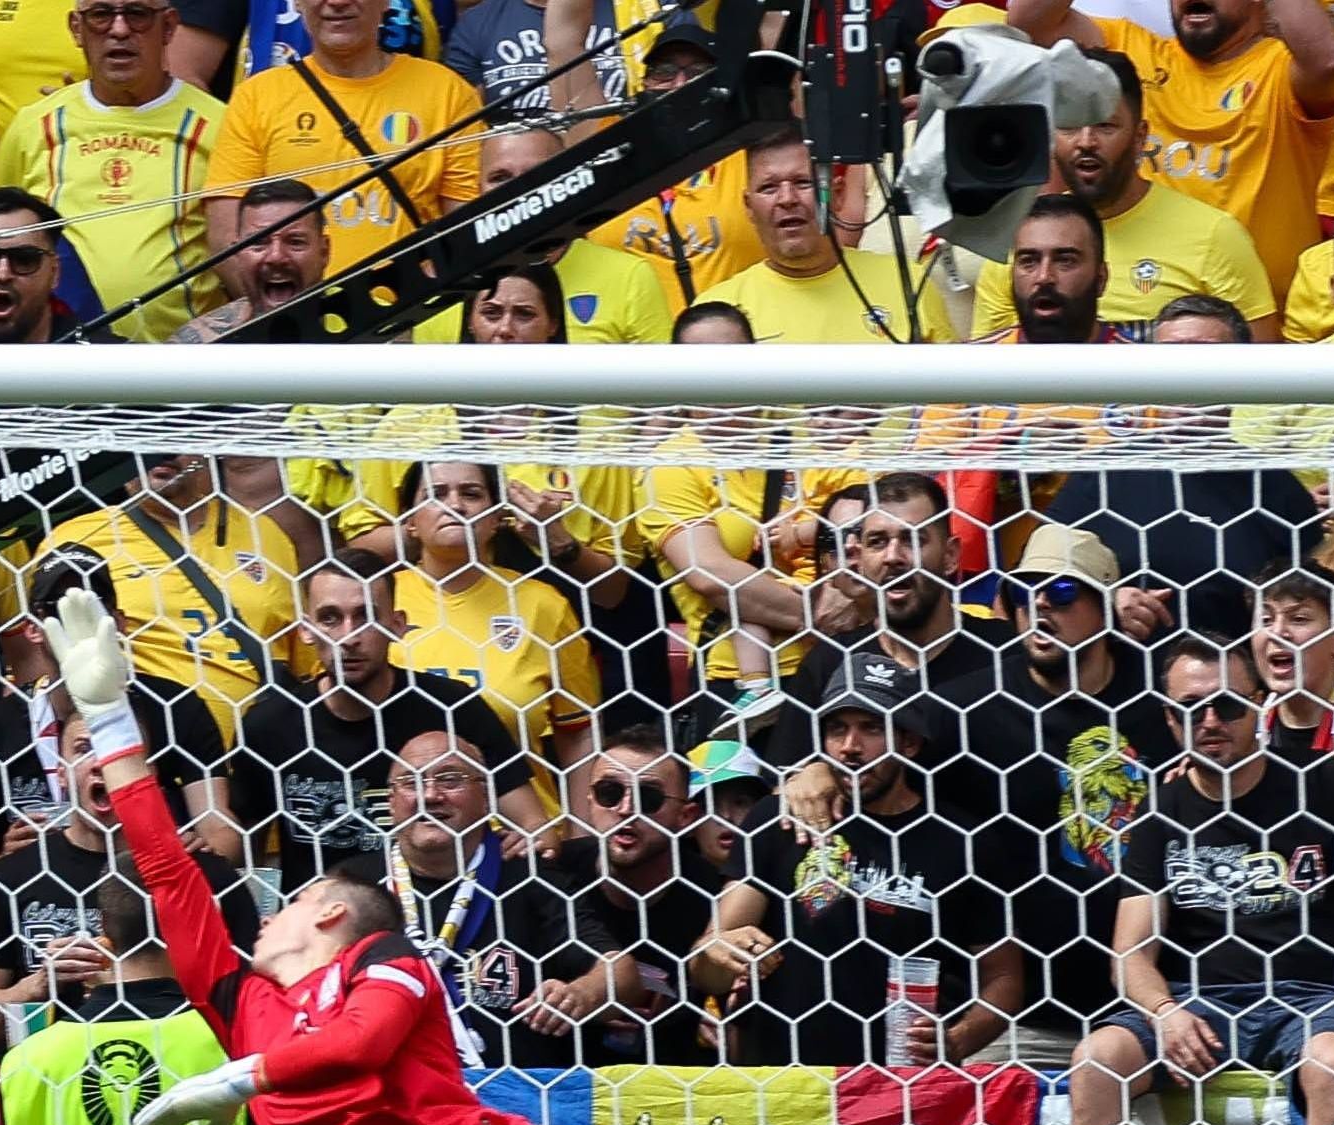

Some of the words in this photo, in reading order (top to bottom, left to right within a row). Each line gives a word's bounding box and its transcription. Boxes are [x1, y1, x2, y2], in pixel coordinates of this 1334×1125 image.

[79, 132, 161, 157] ROMÂNIA
[316, 188, 399, 228] OU
[474, 166, 595, 244] MovieTech
